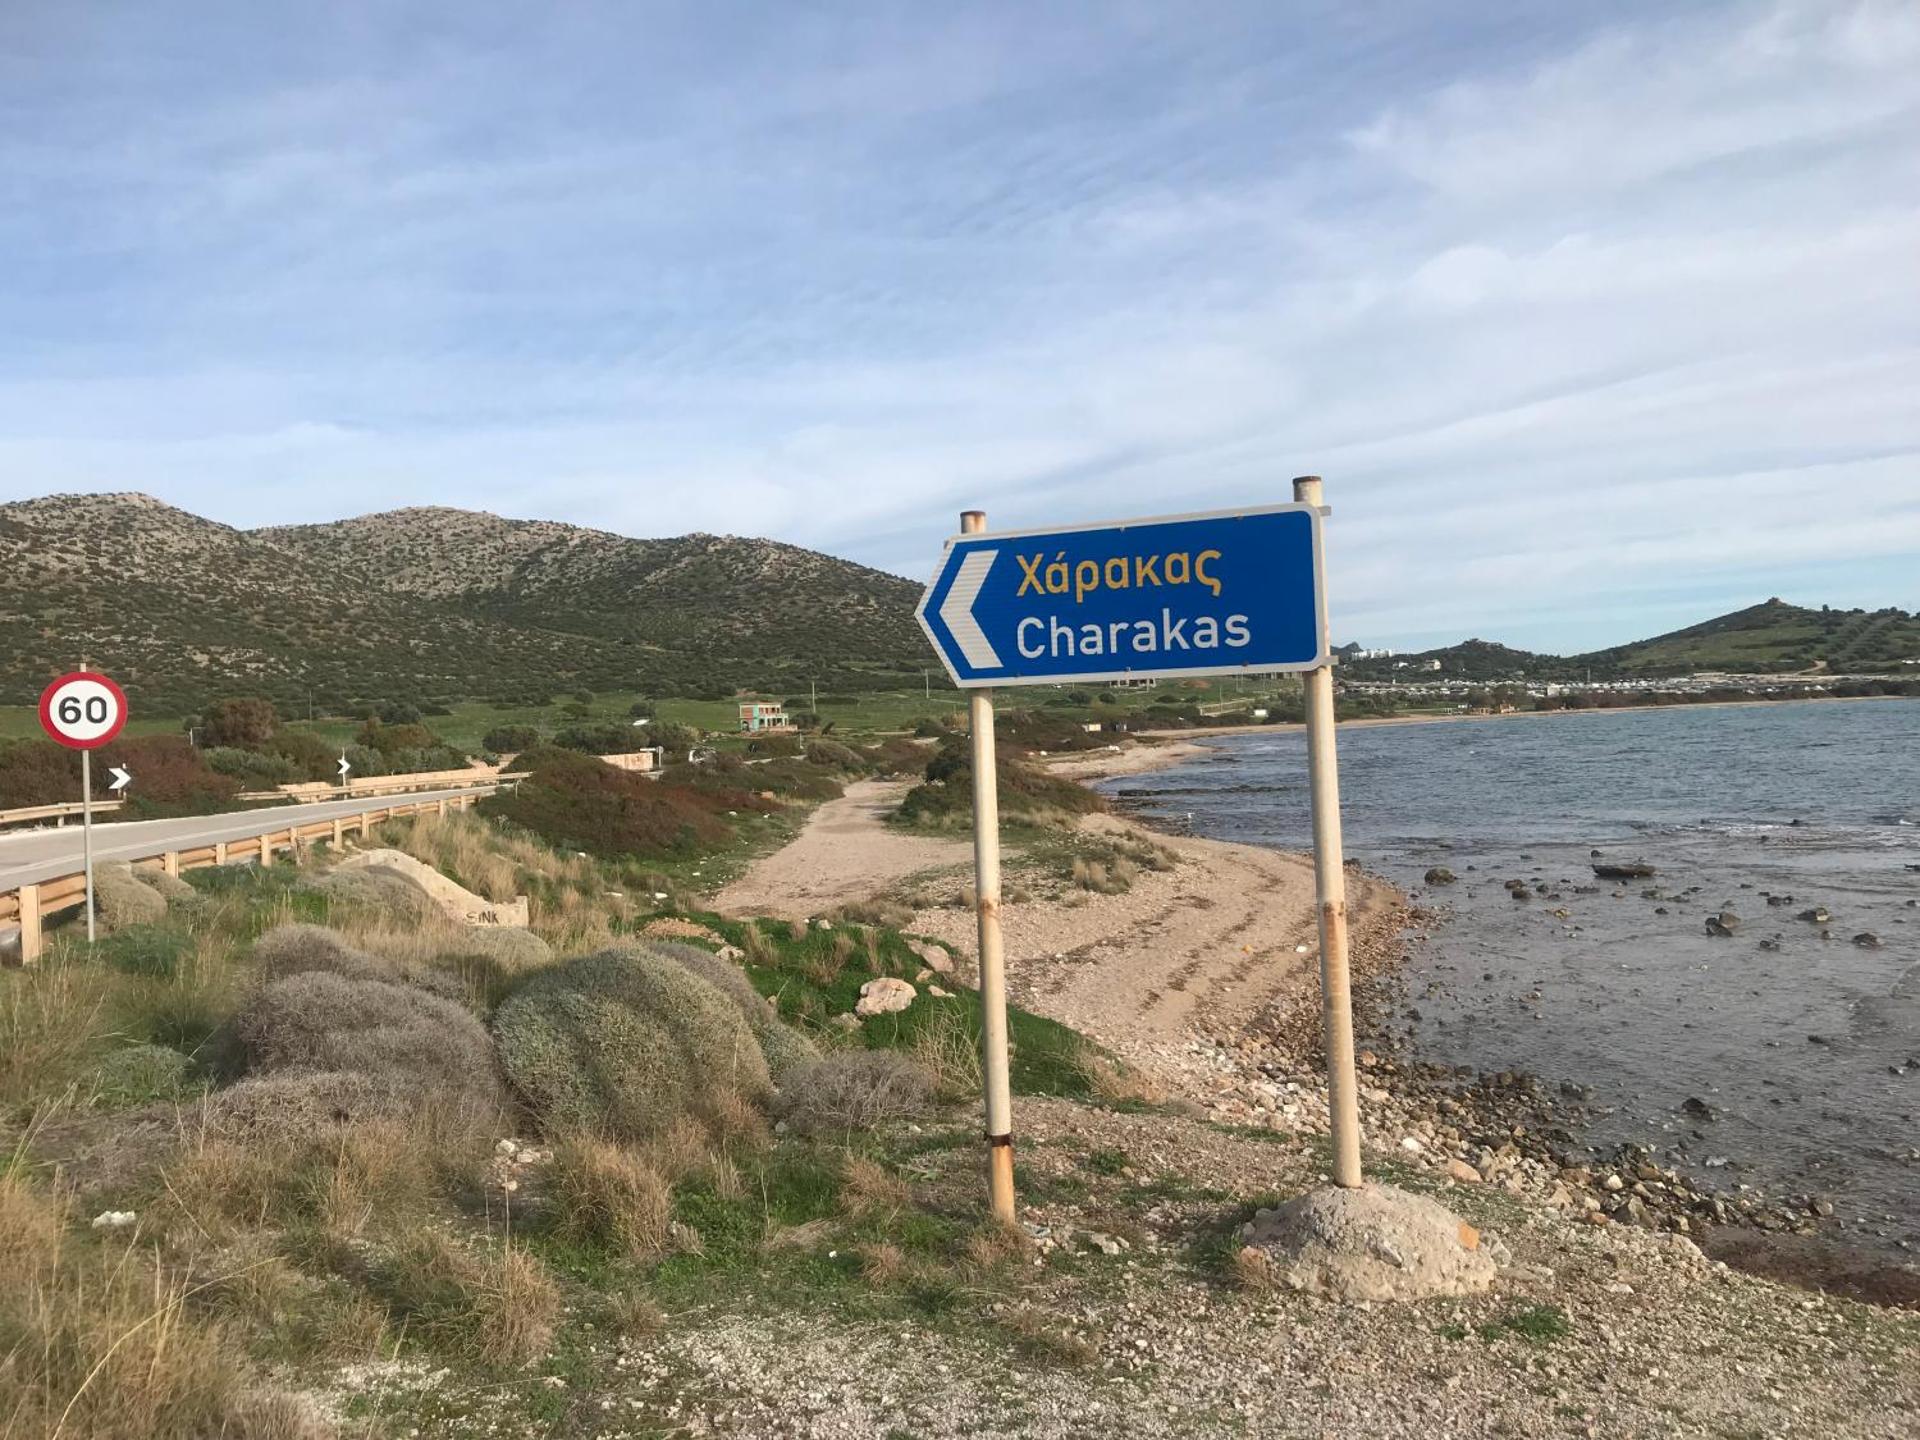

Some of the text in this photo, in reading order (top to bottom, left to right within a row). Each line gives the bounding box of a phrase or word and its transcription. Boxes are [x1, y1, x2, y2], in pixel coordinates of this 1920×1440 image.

[1016, 550, 1222, 603] Χάρακας
[1017, 609, 1251, 658] Charakas
[59, 696, 107, 724] 60
